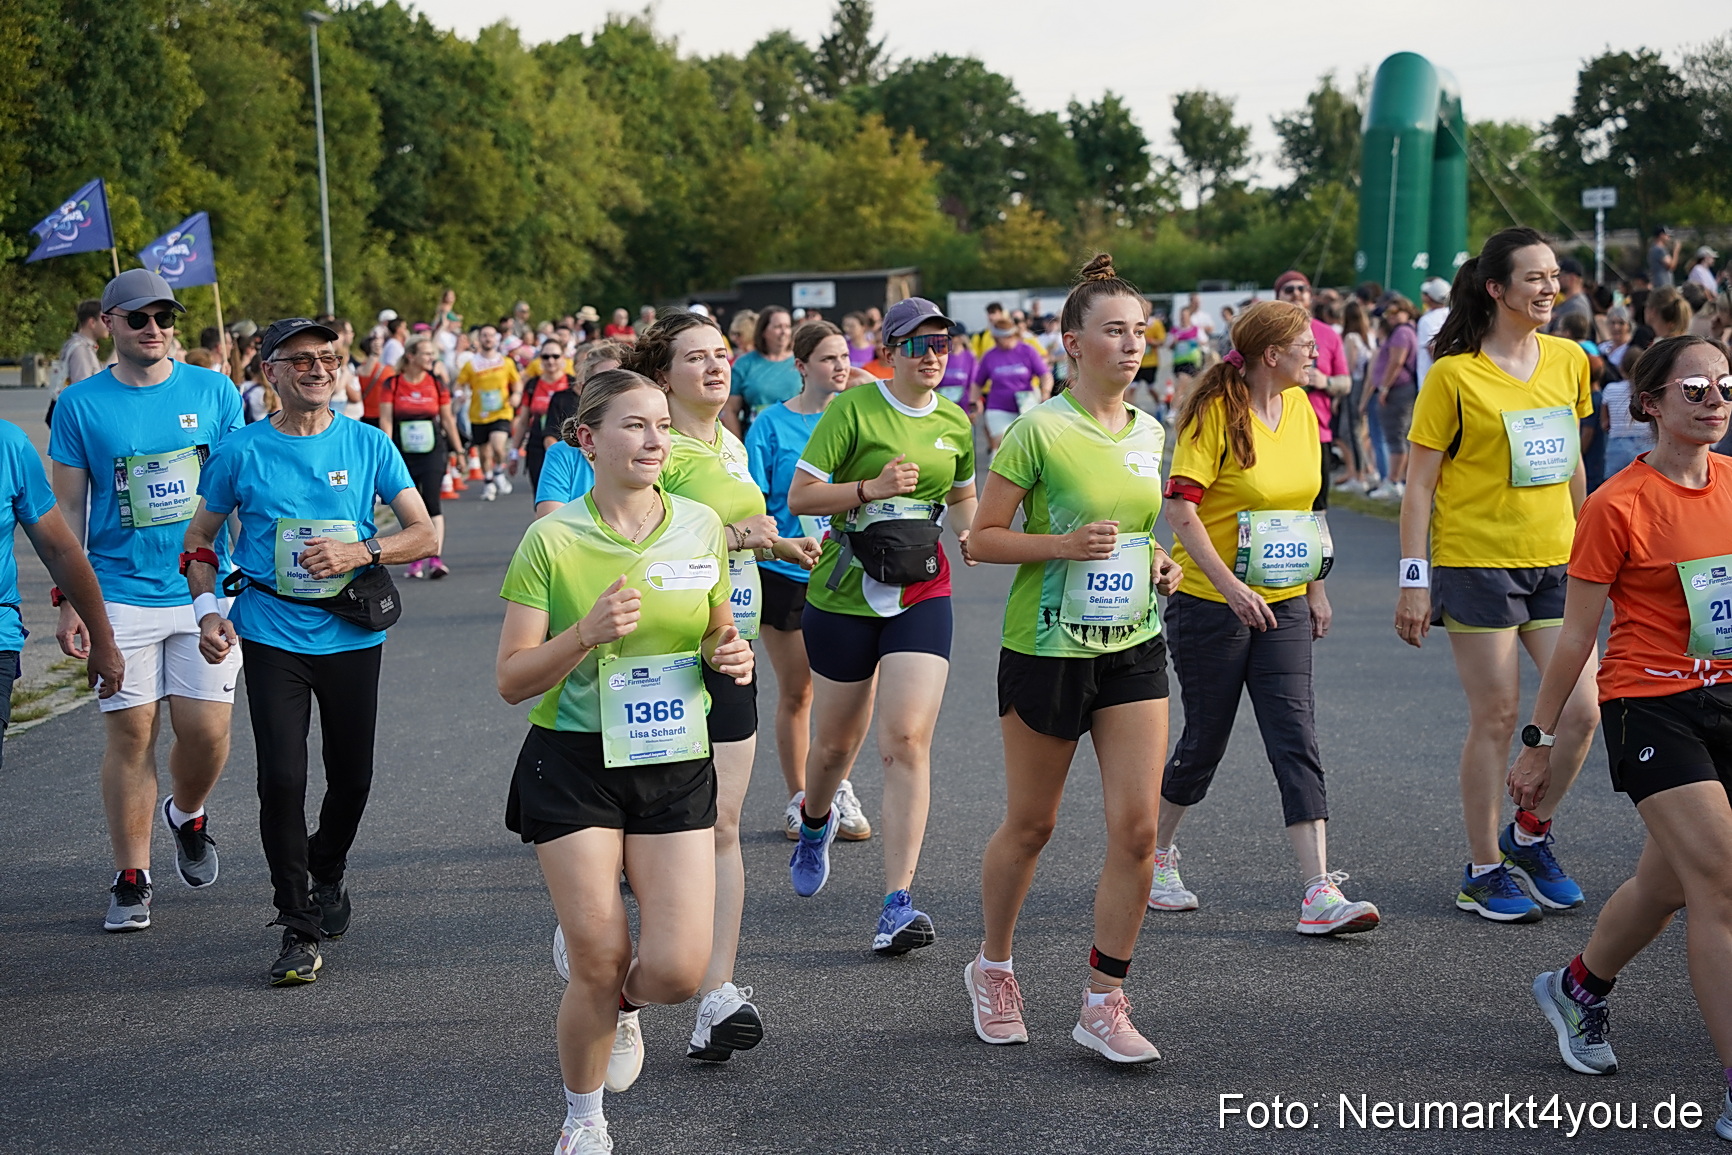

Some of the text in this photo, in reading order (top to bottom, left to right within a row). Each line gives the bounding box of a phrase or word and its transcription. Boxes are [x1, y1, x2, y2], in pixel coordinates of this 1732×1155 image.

[1523, 437, 1565, 457] 2337
[1529, 459, 1547, 467] Petra
[147, 480, 186, 499] 1541
[148, 500, 173, 509] Florian
[173, 497, 191, 506] Beyer
[1263, 542, 1308, 559] 2336
[1261, 562, 1284, 570] Sandra
[286, 570, 310, 580] Holger
[1087, 572, 1134, 592] 1330
[730, 587, 752, 607] 49
[1089, 595, 1130, 604] Selina Fink
[1710, 599, 1732, 622] 21
[627, 675, 662, 686] Firmenlauf
[624, 698, 685, 725] 1366
[629, 726, 687, 739] Lisa Schardt
